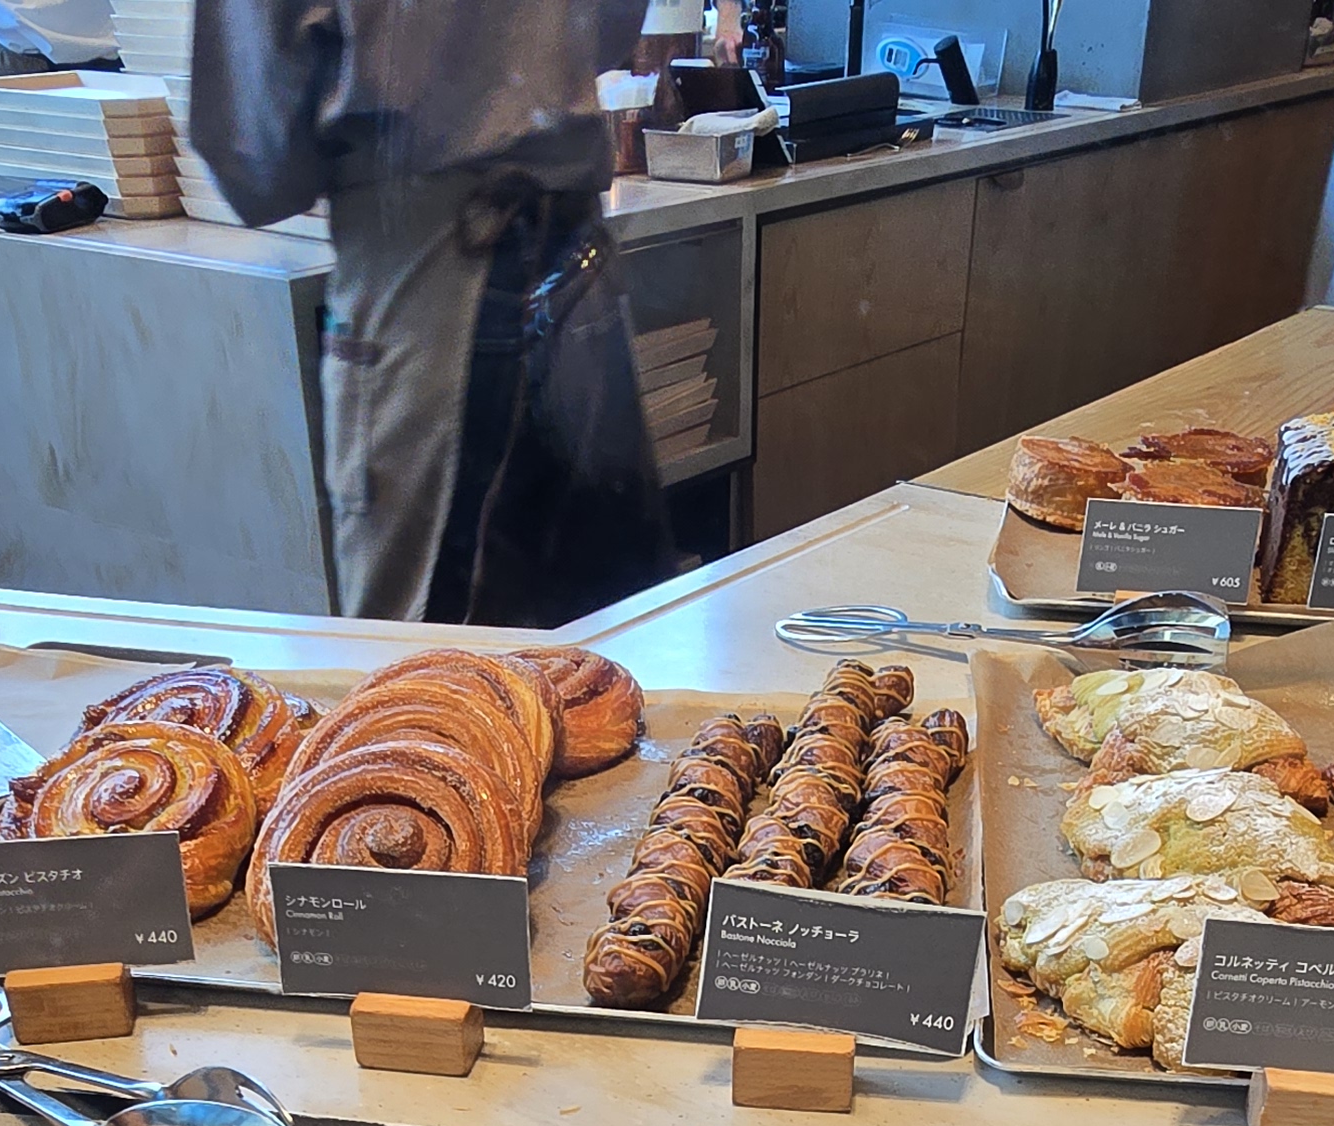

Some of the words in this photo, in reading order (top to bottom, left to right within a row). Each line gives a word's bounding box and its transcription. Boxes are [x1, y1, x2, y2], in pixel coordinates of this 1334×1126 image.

[1154, 524, 1185, 535] シュガー
[1212, 577, 1241, 588] ¥605
[285, 895, 367, 911] シナモンロール
[722, 914, 784, 933] バストーネ
[788, 923, 860, 944] ノッチョーラ
[135, 930, 178, 945] ¥440
[756, 935, 796, 948] Nocciola
[1214, 955, 1289, 972] コルネッティ
[475, 974, 516, 988] ¥420
[1211, 971, 1247, 982] Cornetti
[1250, 973, 1288, 987] Coperto
[1289, 977, 1334, 990] Pistacchio
[910, 1013, 954, 1031] ¥440
